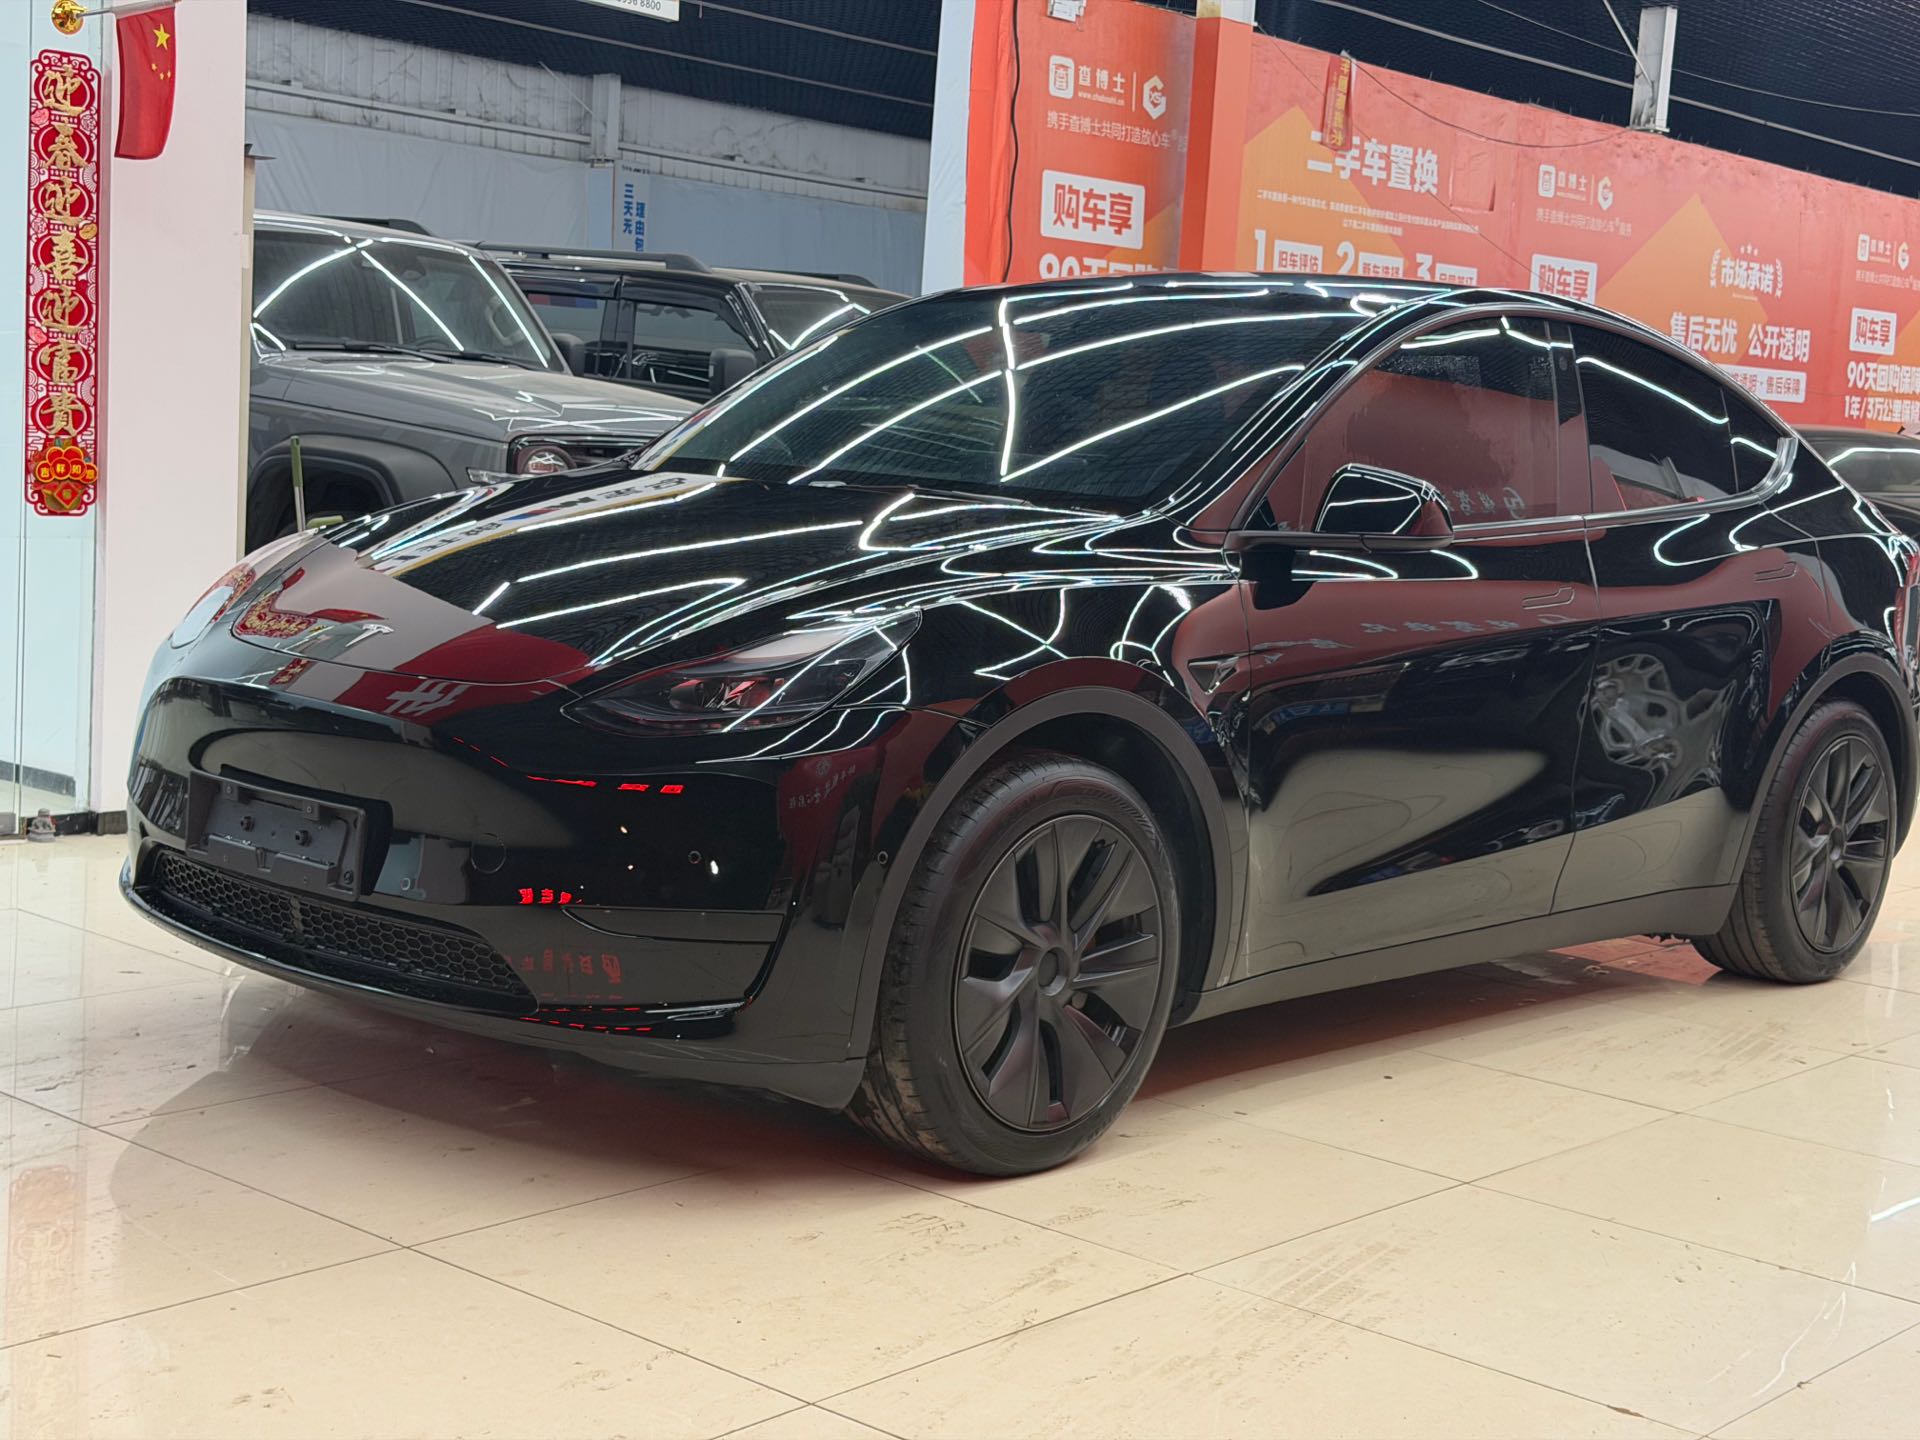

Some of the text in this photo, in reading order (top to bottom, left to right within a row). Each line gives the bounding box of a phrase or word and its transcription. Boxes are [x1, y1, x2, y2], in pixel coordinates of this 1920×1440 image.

[1078, 65, 1125, 94] 查博士
[1053, 183, 1133, 235] 购车享
[1336, 241, 1355, 275] 2
[1721, 258, 1774, 295] 市场承诺
[1670, 312, 1811, 363] 售后无忧 公开透明
[1855, 315, 1892, 347] 购车享
